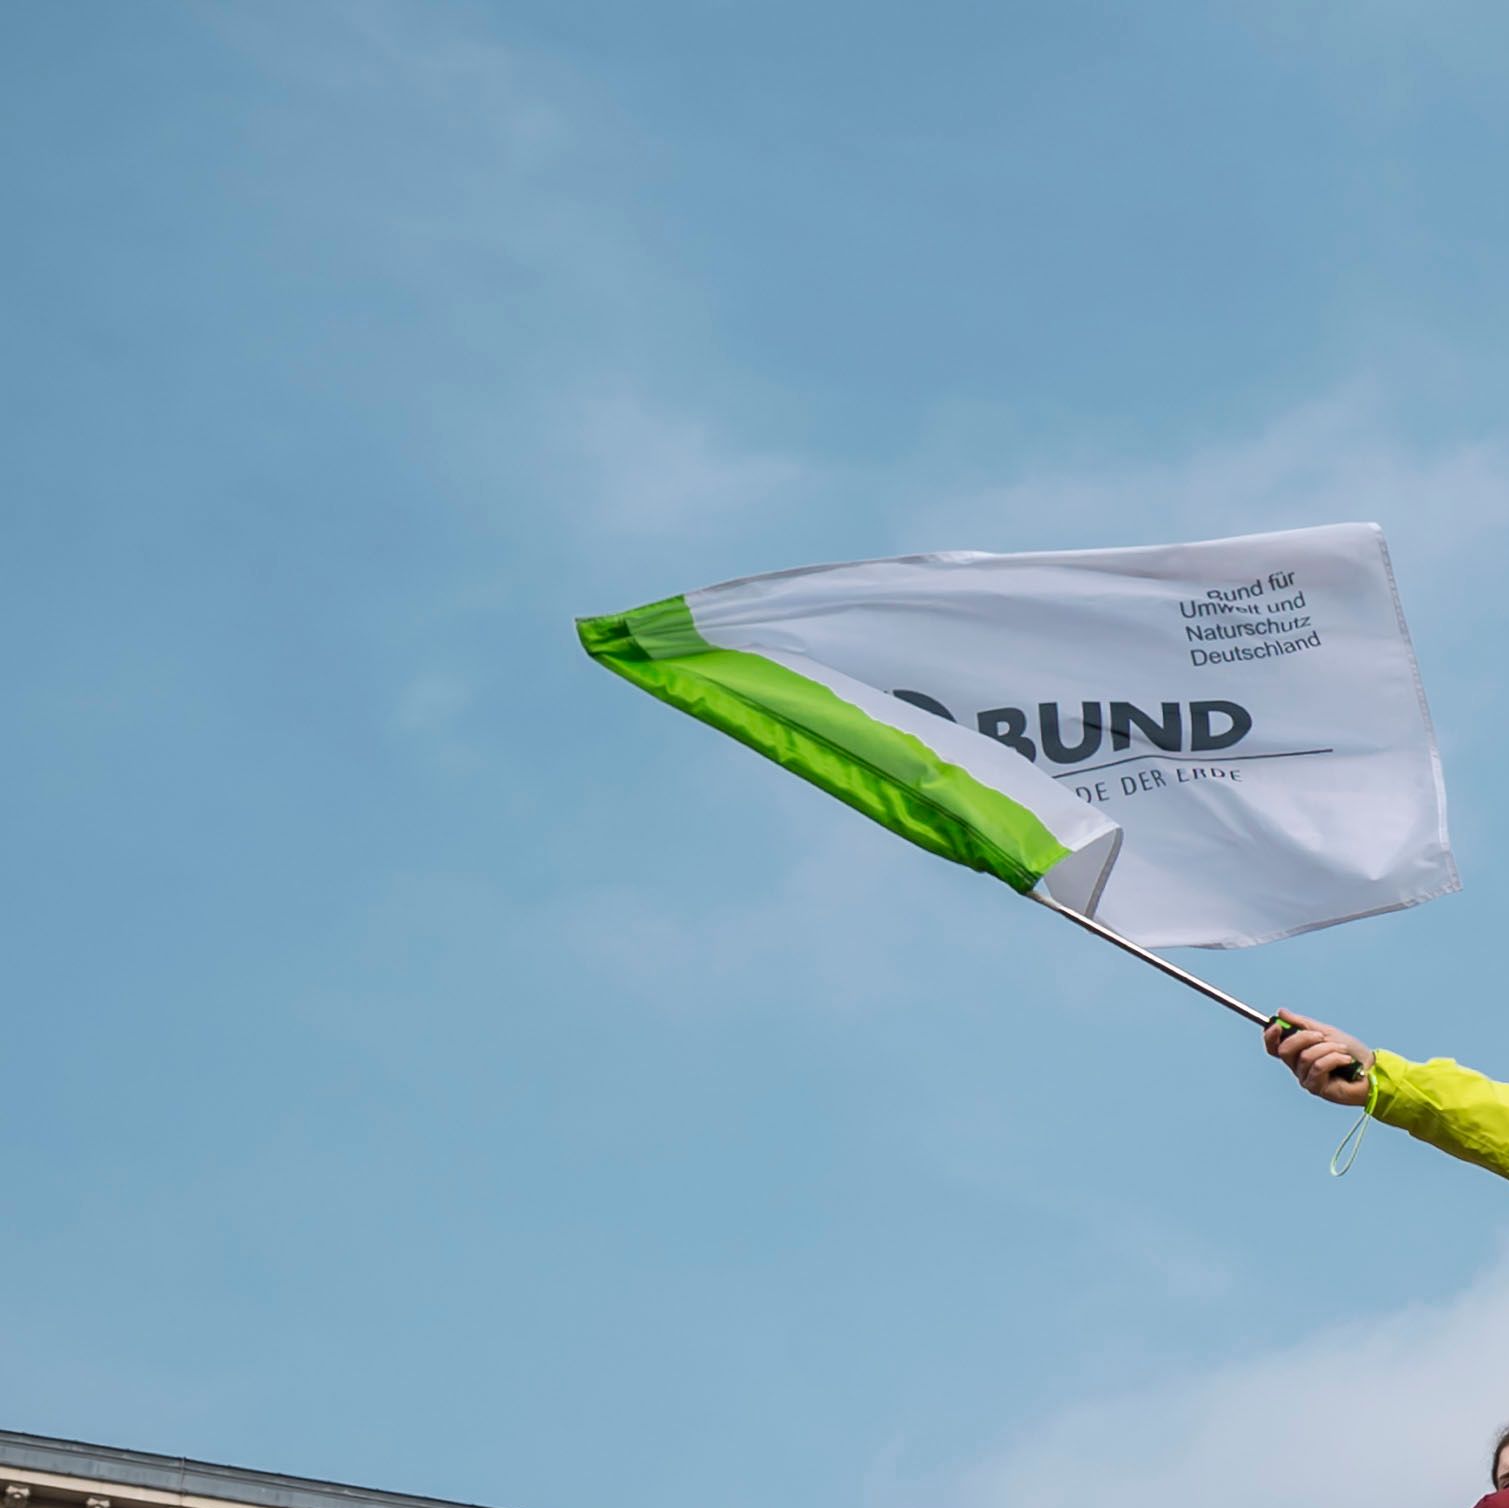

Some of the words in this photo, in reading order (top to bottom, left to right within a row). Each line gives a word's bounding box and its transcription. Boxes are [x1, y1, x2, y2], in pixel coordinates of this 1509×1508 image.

[1207, 579, 1263, 602] Bund
[1268, 571, 1296, 592] für
[1180, 600, 1262, 619] Umwelt
[1267, 590, 1306, 614] und
[1185, 615, 1312, 642] Naturschutz
[1190, 630, 1322, 667] Deutschland
[976, 699, 1253, 765] BUND
[1122, 770, 1166, 796] DER
